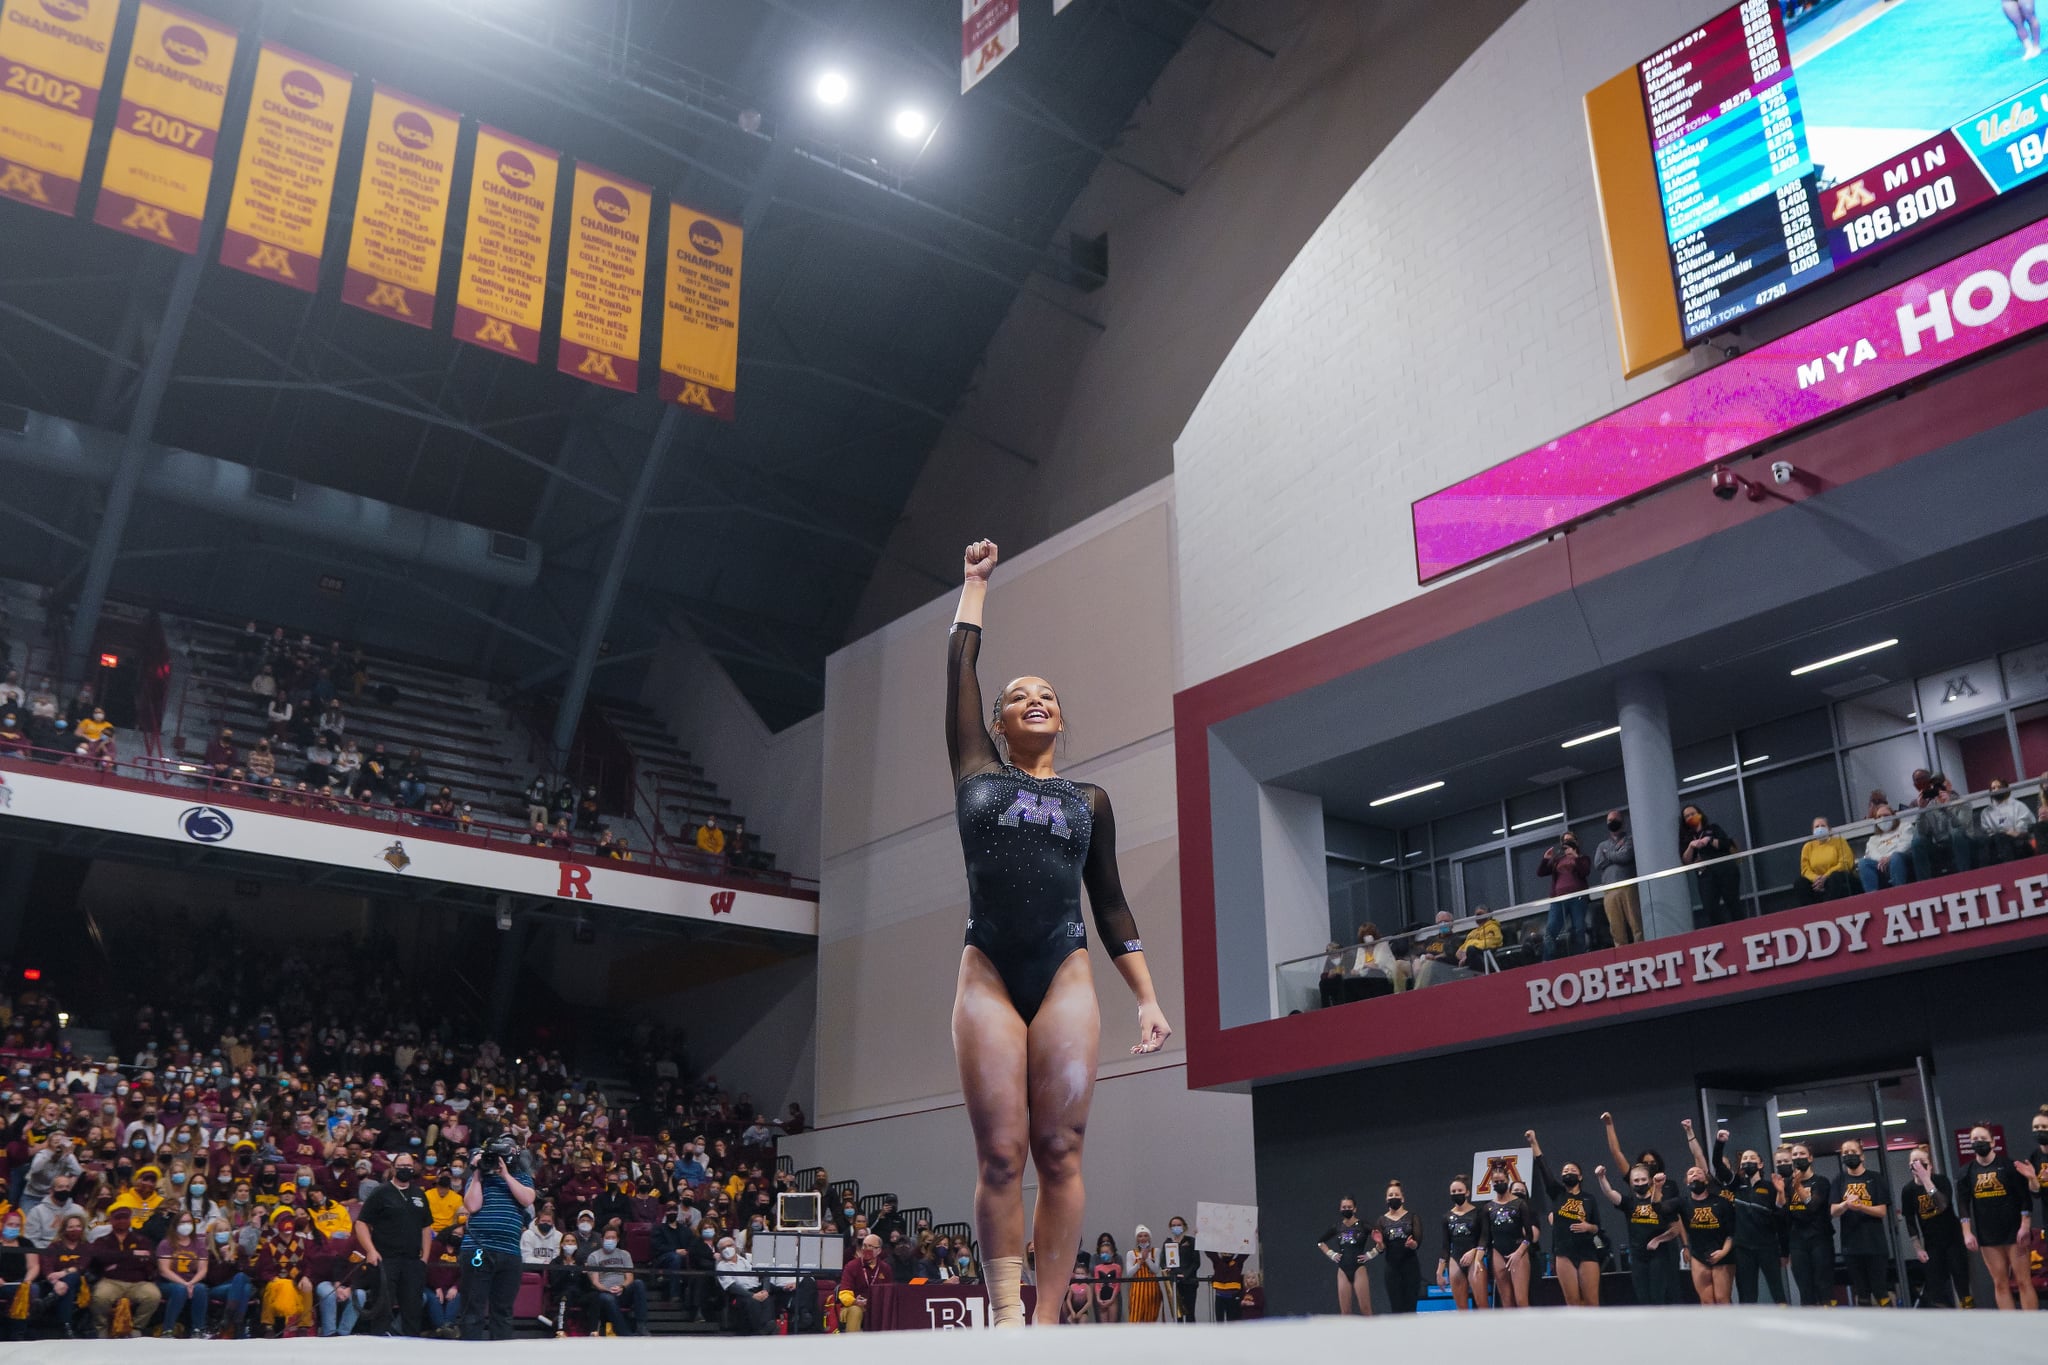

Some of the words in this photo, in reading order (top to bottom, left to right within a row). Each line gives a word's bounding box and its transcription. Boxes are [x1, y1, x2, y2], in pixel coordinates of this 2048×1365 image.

[9, 10, 105, 53] CHAMPIONS
[1642, 29, 1707, 72] MINNESOTA
[1751, 48, 1778, 72] 0.000
[133, 54, 224, 96] CHAMPIONS
[1753, 60, 1781, 84] 0.000
[6, 67, 82, 109] 2002
[132, 107, 203, 151] 2007
[261, 98, 334, 133] CHAMPION
[1659, 130, 1684, 147] EVENT
[1685, 114, 1712, 134] TOTAL
[376, 140, 443, 173] CHAMPION
[1657, 139, 1687, 159] UCLA
[499, 163, 533, 184] NCAA
[1832, 179, 1876, 220] M
[1883, 144, 1946, 192] MIN
[482, 179, 544, 211] CHAMPION
[596, 198, 628, 218] NCAA
[1672, 230, 1704, 251] IOWA
[1776, 178, 1802, 200] BARS
[1843, 175, 1957, 253] 186.800
[580, 215, 638, 244] CHAMPION
[692, 233, 721, 250] NCAA
[478, 235, 499, 250] LUKE
[502, 244, 535, 262] BECKER
[579, 250, 599, 264] COLE
[602, 258, 634, 276] KONRAD
[676, 248, 732, 276] CHAMPION
[368, 261, 418, 283] WRESTLING
[466, 251, 495, 268] JARED
[497, 262, 542, 285] LAWRENCE
[1791, 252, 1820, 276] 0.000
[471, 274, 504, 292] DAMION
[677, 284, 695, 296] TONY
[699, 291, 728, 308] NELSON
[476, 297, 524, 319] WRESTLING
[575, 289, 596, 302] COLE
[598, 297, 631, 314] KONRAD
[475, 317, 518, 352] M
[573, 309, 604, 325] JAYSON
[607, 319, 628, 333] NESS
[1690, 315, 1717, 335] EVENT
[1718, 304, 1747, 323] TOTAL
[577, 330, 623, 350] WRESTLING
[578, 349, 618, 382] M
[676, 362, 719, 382] WRESTLING
[1796, 337, 1878, 389] MYA
[677, 380, 716, 412] M
[998, 788, 1072, 840] M
[557, 862, 593, 901] R
[710, 890, 736, 916] W
[1526, 949, 1684, 1014] ROBERT
[1690, 943, 1737, 982] K.
[1742, 912, 1871, 972] EDDY
[1882, 873, 2048, 946] ATHLE
[1974, 1172, 2004, 1192] M
